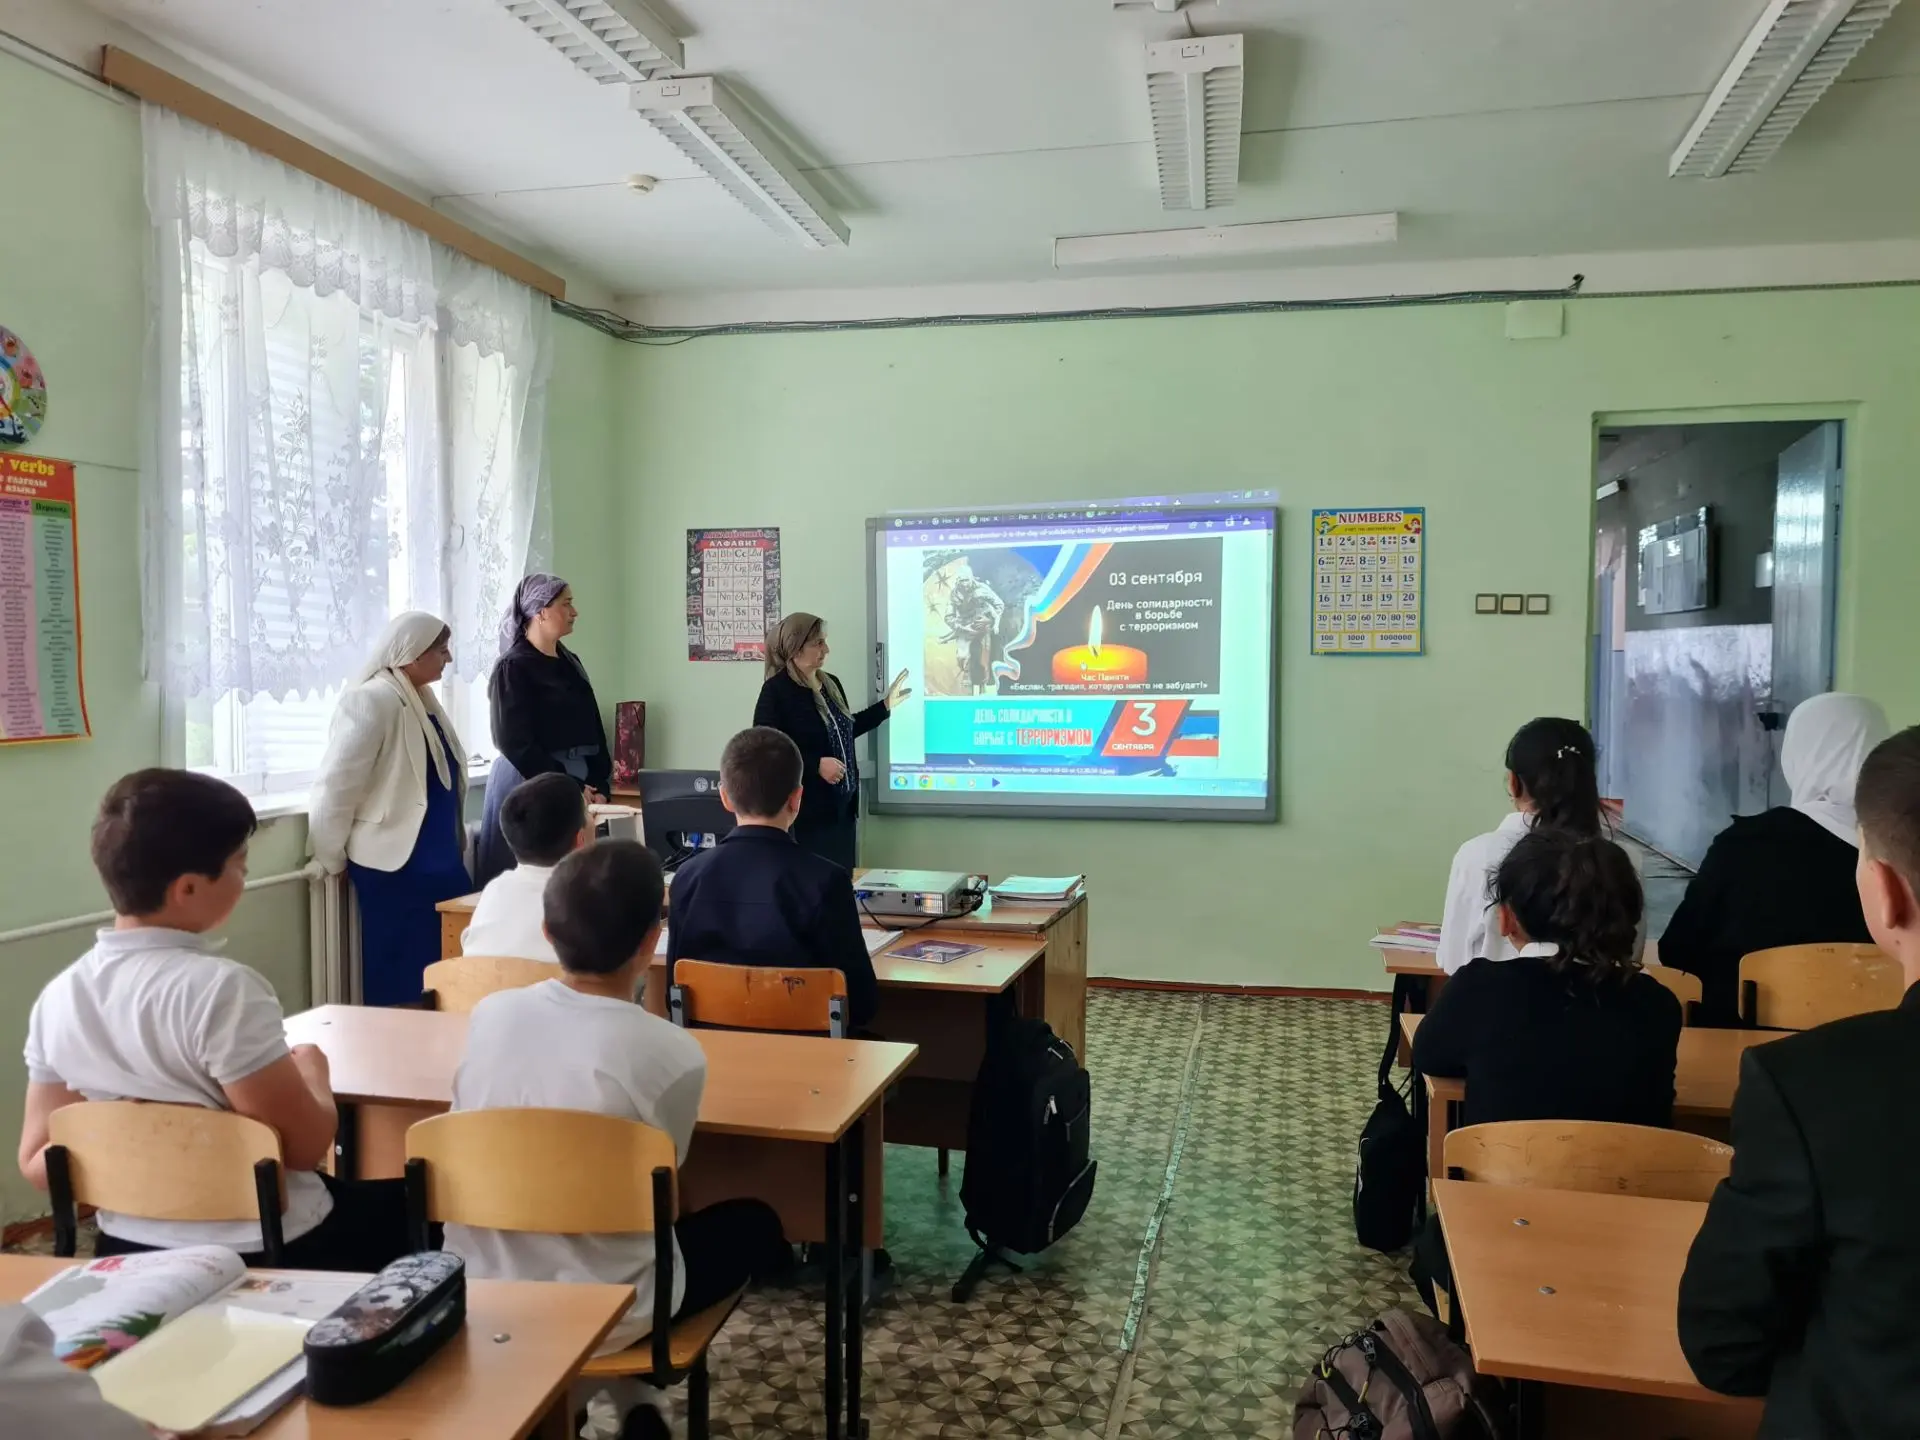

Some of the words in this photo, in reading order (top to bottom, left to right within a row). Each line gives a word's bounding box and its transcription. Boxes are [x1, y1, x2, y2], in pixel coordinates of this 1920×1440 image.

[10, 459, 55, 476] verbs
[1339, 513, 1402, 523] NUMBERS
[1320, 537, 1324, 546] 1
[1339, 537, 1345, 546] 2
[1360, 537, 1366, 545] 3
[1380, 537, 1386, 545] 4
[1401, 536, 1407, 544] 5
[1318, 557, 1324, 565] 6
[1339, 557, 1345, 565] 7
[1360, 557, 1366, 565] 8
[1380, 556, 1386, 564] 9
[1403, 556, 1414, 564] 10
[1110, 572, 1126, 586] 03
[1131, 570, 1202, 586] сентября
[1107, 600, 1133, 610] День
[1136, 598, 1212, 609] солидарности
[1145, 610, 1182, 621] борьбе
[1130, 622, 1198, 632] терроризмом
[974, 709, 995, 723] ДЕНЬ
[1131, 702, 1156, 736] 3
[1016, 729, 1093, 746] ТЕРРОРИЗМОМ
[1111, 742, 1155, 751] СЕНТЯБРЯ
